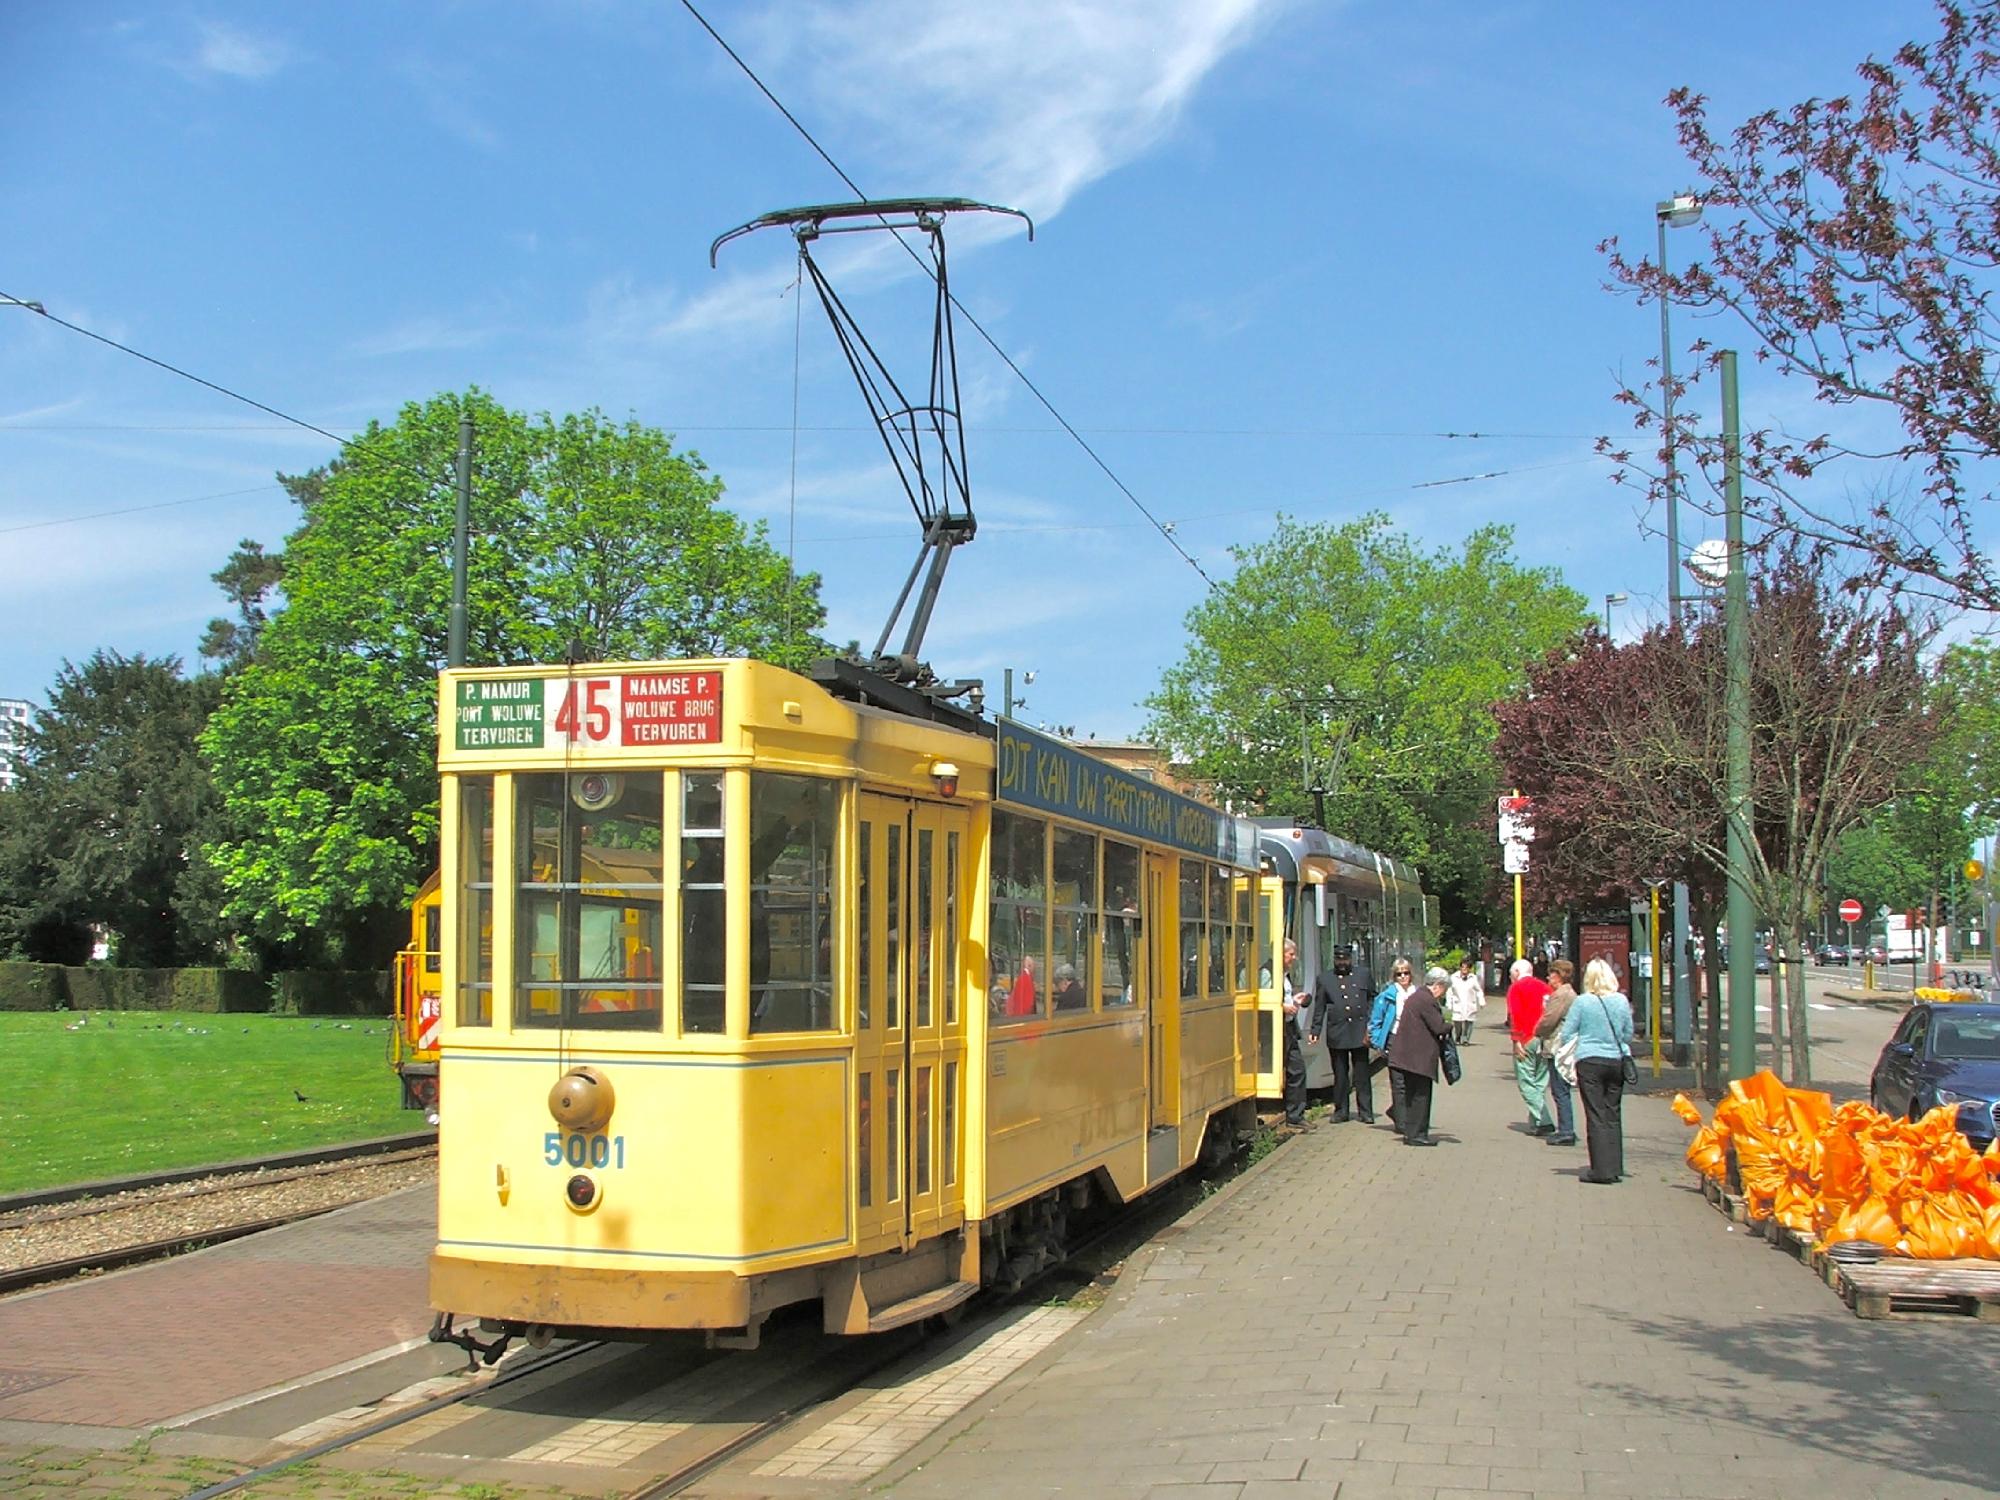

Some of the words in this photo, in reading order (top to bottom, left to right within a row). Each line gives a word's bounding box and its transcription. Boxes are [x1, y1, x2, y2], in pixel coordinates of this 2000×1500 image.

[466, 683, 477, 700] P.
[481, 682, 531, 700] NAMUR
[629, 678, 690, 696] NAAMSE
[697, 677, 709, 694] P.
[456, 705, 483, 723] PONT
[492, 704, 542, 722] WOLUWE
[555, 680, 611, 742] 45
[624, 701, 677, 719] WOLUWE
[684, 700, 714, 717] BRUG
[463, 727, 534, 745] TERVUREN
[632, 723, 706, 741] TERVUREN
[1002, 736, 1031, 793] DIT
[1036, 748, 1069, 805] KAN
[1077, 764, 1099, 816] UW
[1103, 775, 1171, 842] PARTYTRAM
[544, 1132, 624, 1169] 5001
